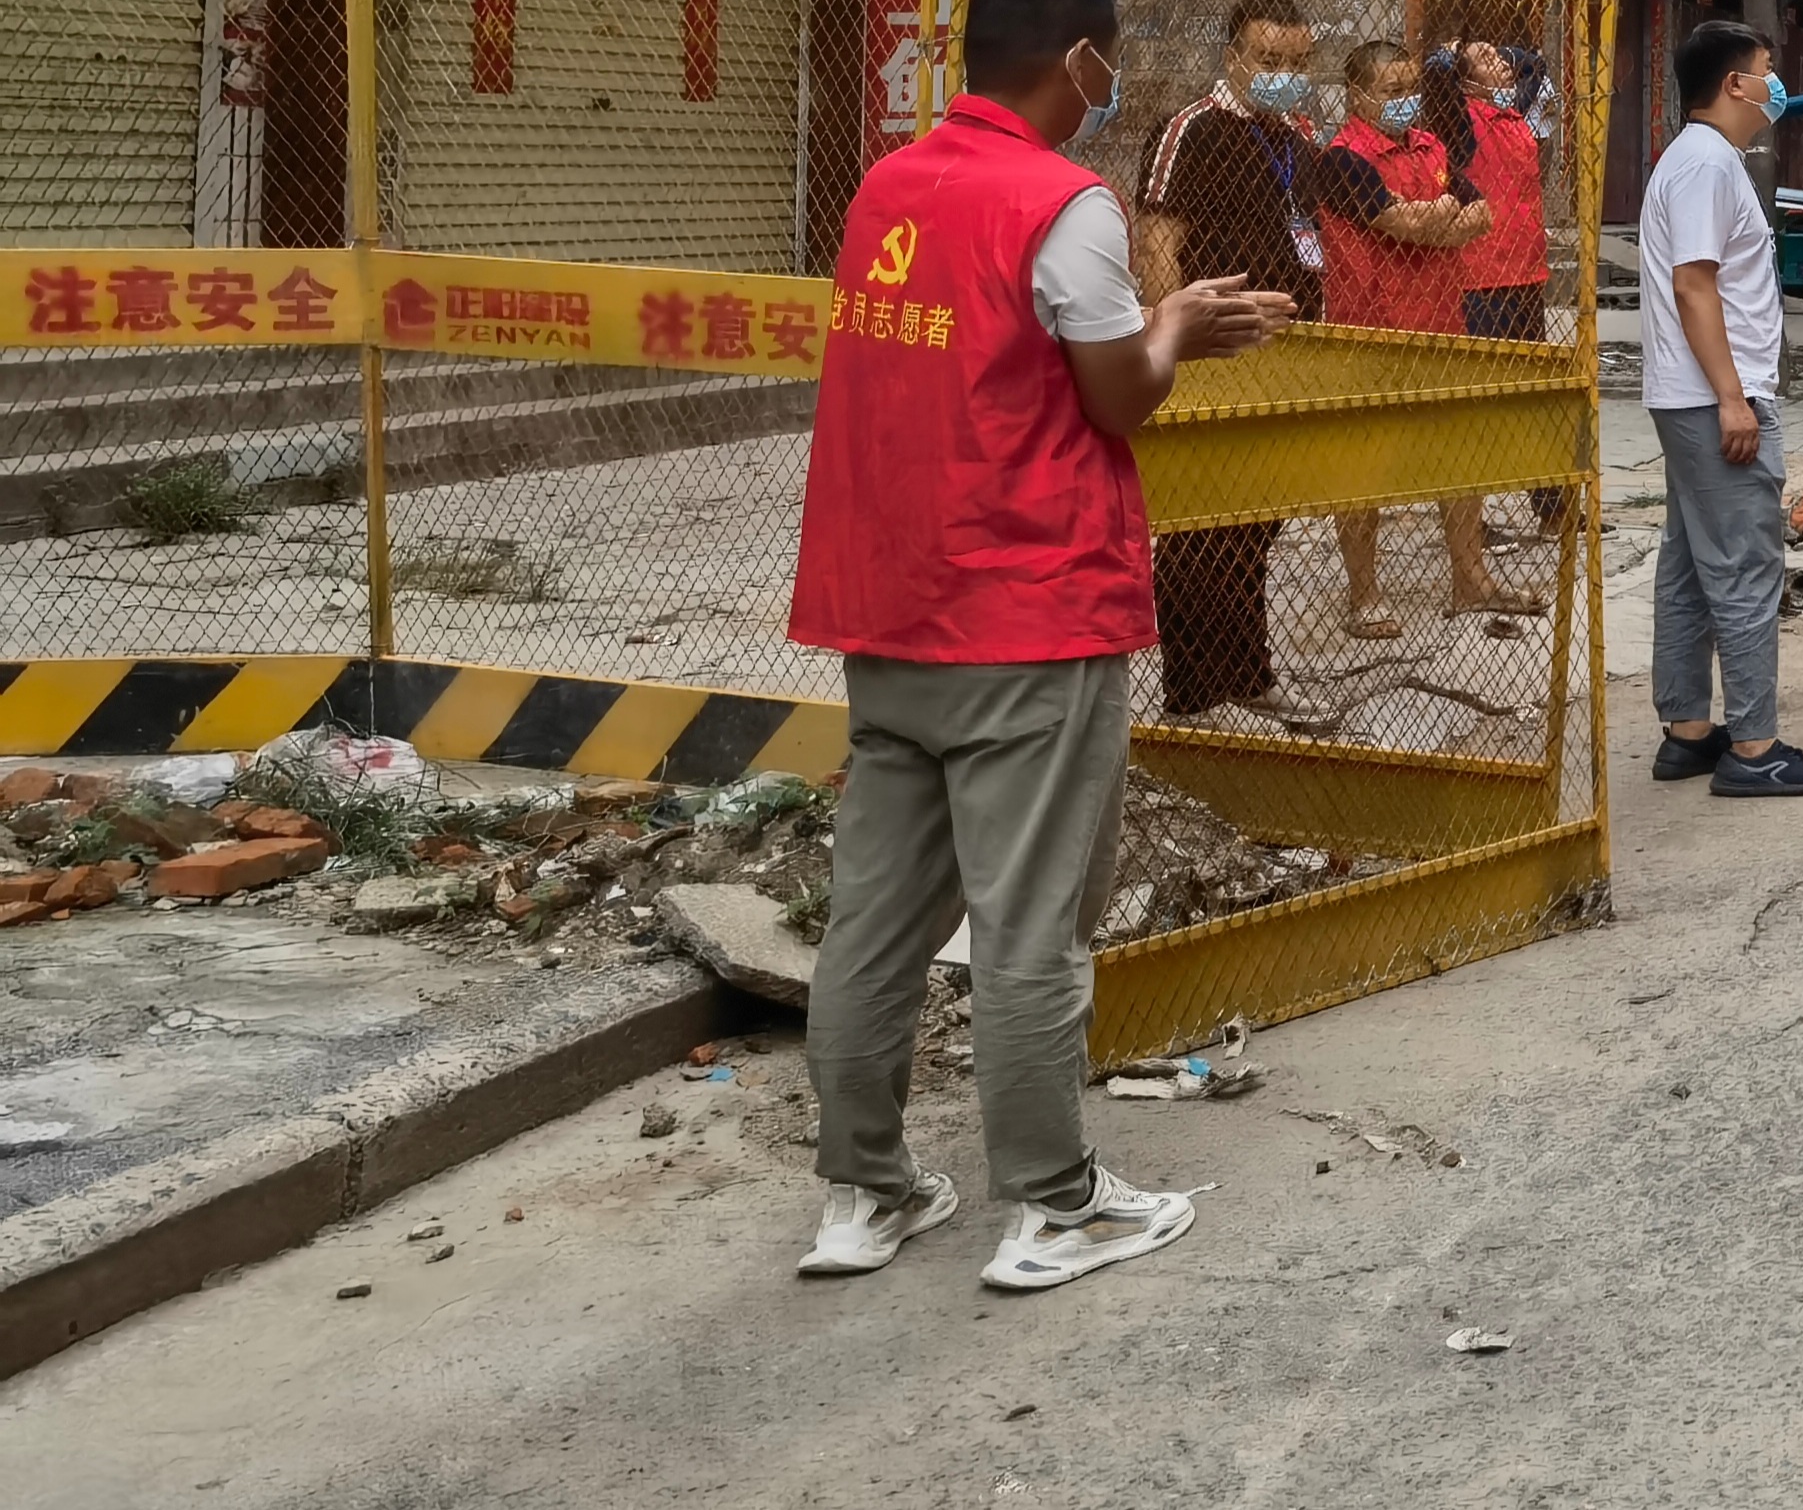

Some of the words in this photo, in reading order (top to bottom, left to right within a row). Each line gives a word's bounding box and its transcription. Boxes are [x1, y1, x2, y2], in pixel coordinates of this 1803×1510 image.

[25, 265, 340, 338] 注意安全
[831, 286, 955, 350] 党员志愿者
[447, 324, 590, 351] ZENYAN
